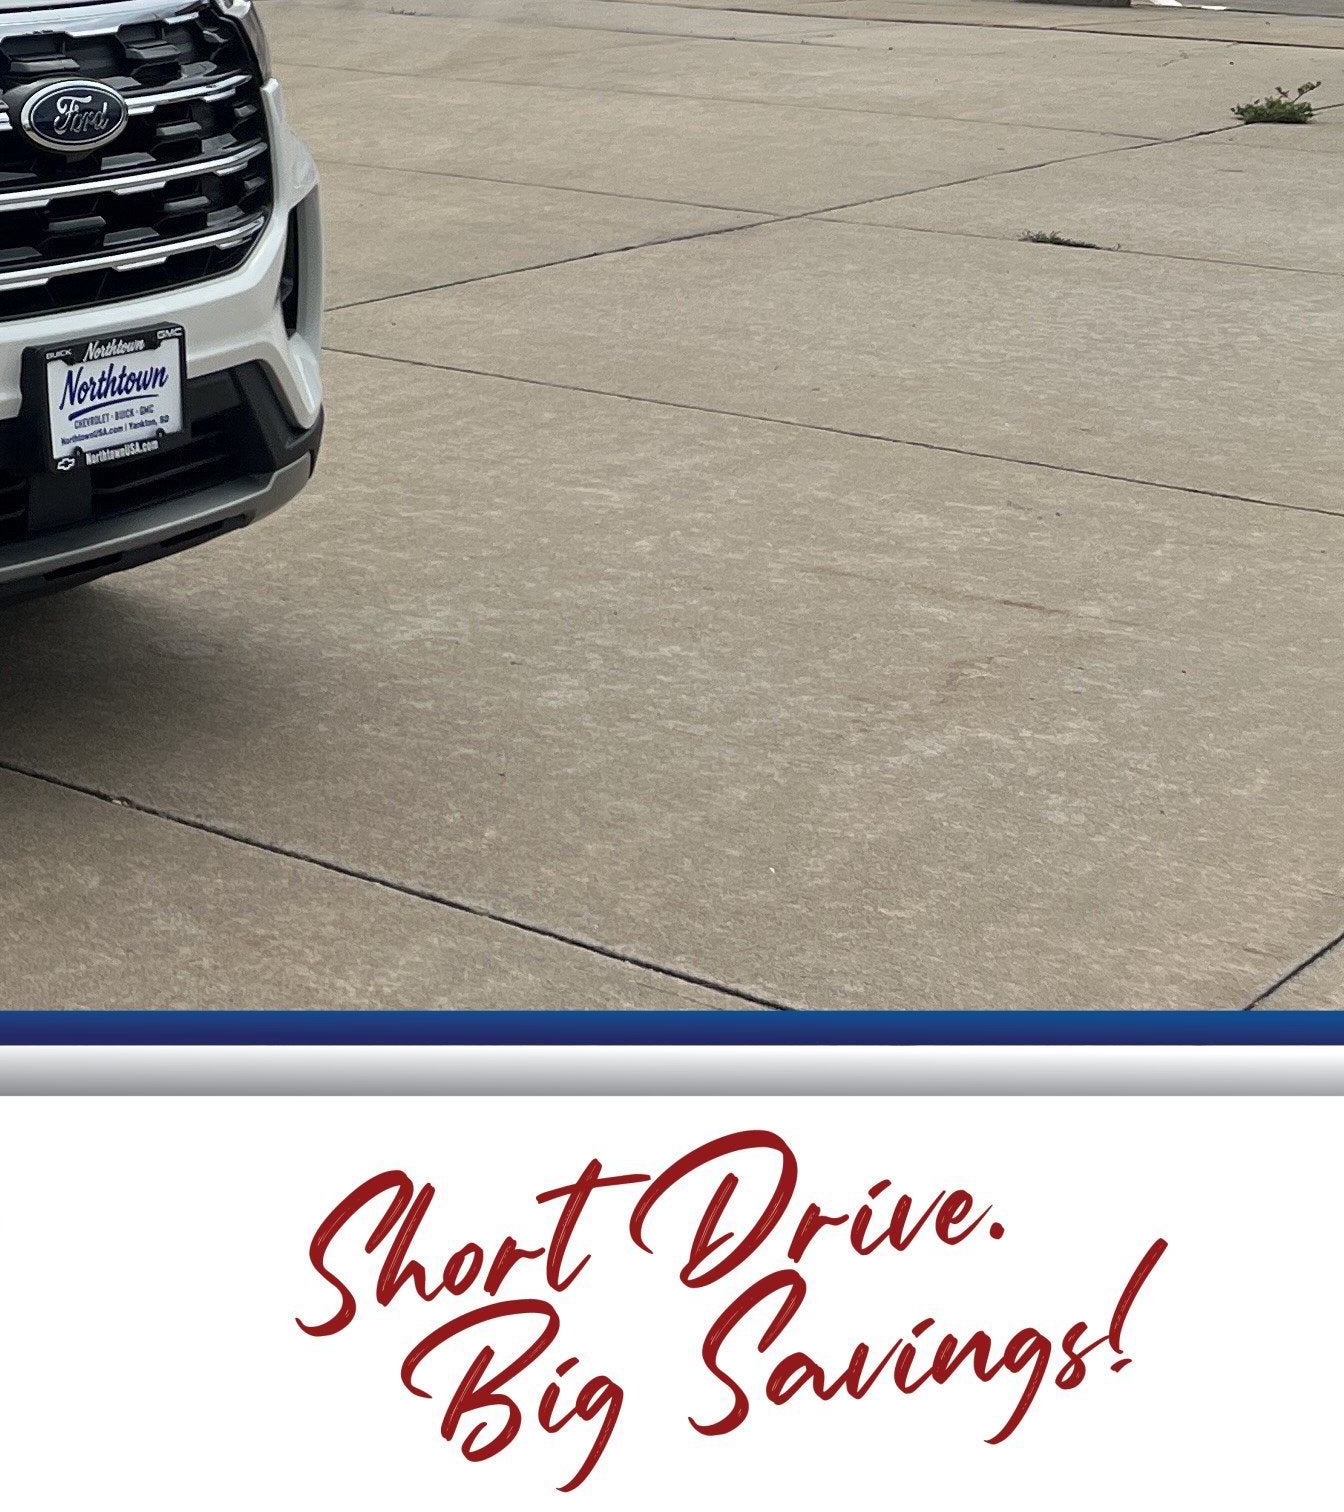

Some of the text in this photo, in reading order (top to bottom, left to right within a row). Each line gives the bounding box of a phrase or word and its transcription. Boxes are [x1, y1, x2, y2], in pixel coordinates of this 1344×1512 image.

[53, 95, 110, 135] Ford
[156, 328, 183, 340] GMC
[45, 349, 73, 360] BUICK
[82, 338, 145, 363] Northtown
[58, 362, 169, 411] Northtown
[74, 404, 154, 429] CHEVROLET BUICK GMC
[60, 426, 124, 446] NorthtownUSA.com
[85, 440, 159, 466] NorthtownUSA.com
